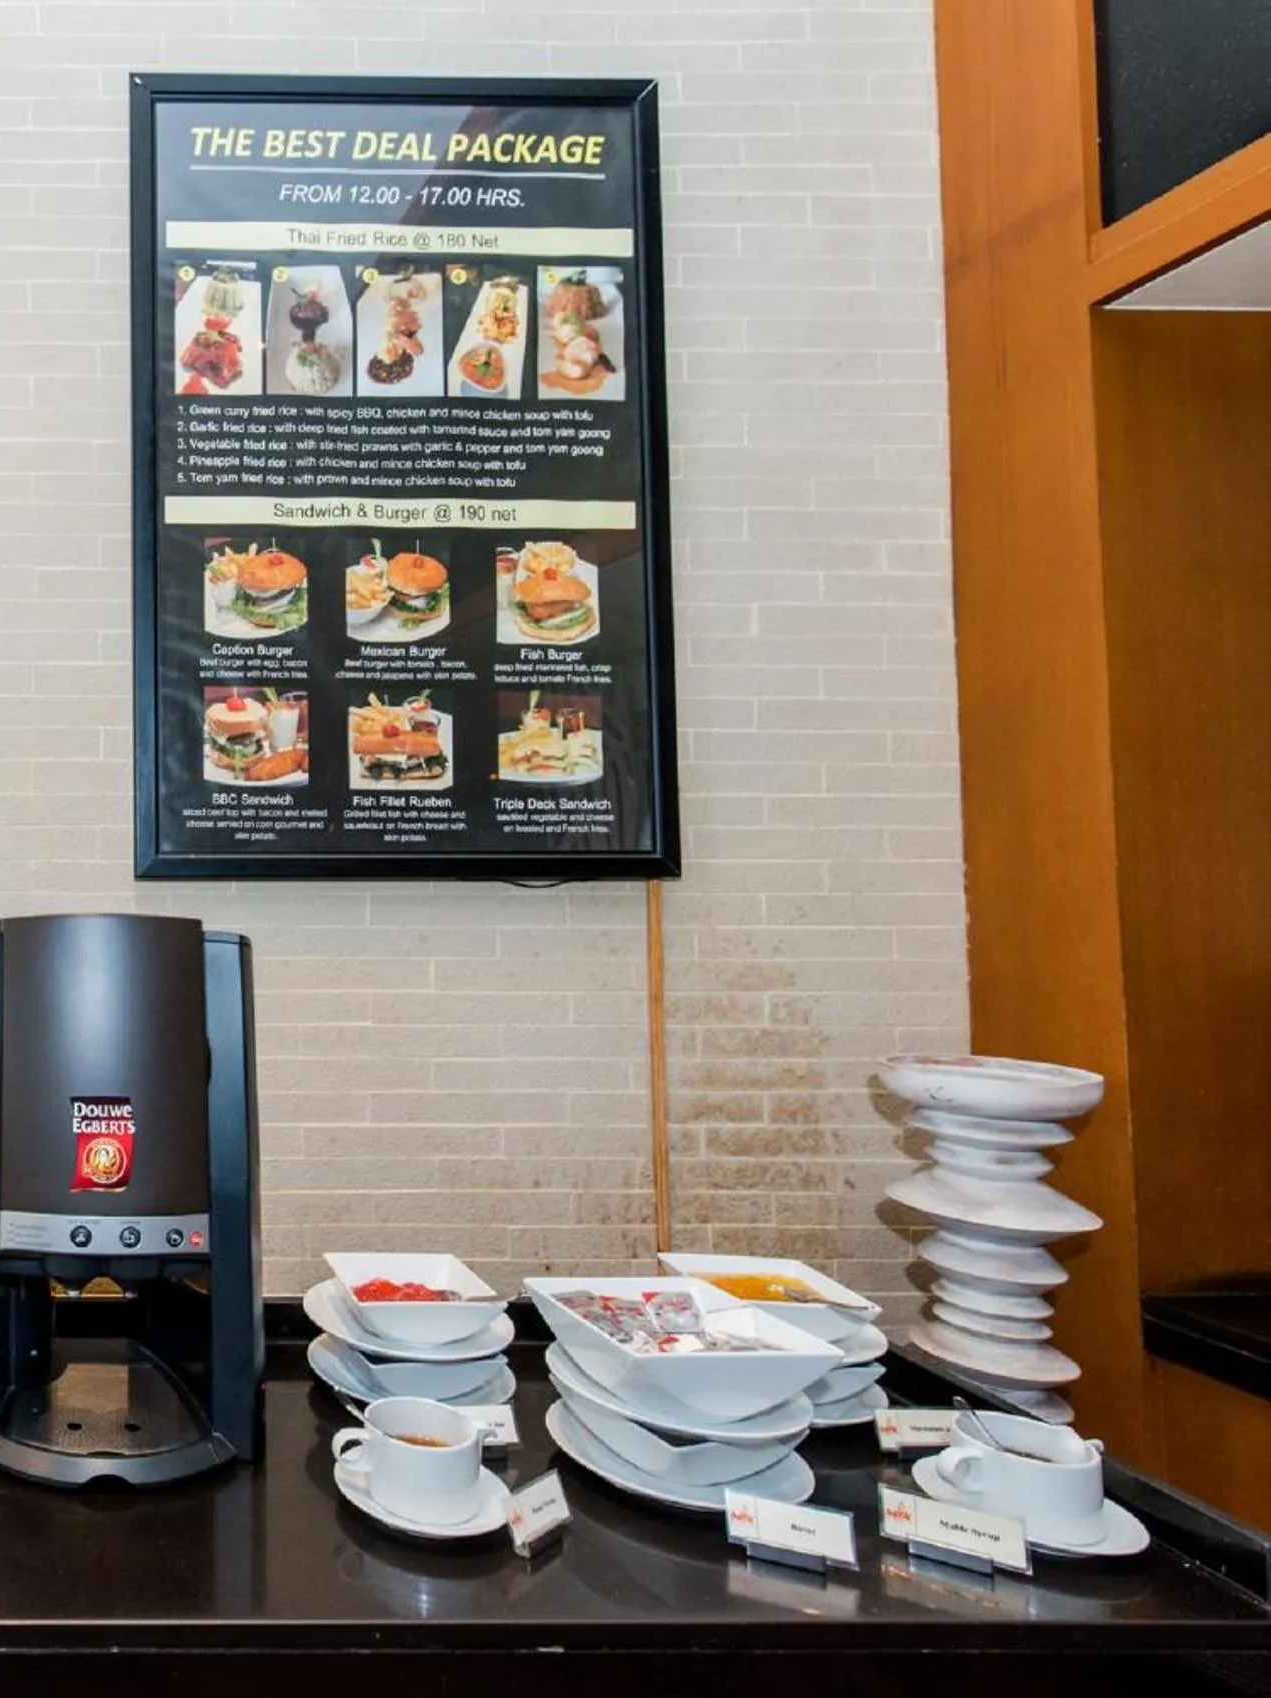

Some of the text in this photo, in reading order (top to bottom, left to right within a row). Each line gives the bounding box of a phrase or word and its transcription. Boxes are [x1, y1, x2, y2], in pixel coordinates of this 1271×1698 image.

[190, 127, 606, 165] THE BEST DEAL PACKAGE
[279, 184, 342, 203] FROM
[349, 185, 399, 204] 12.00
[419, 186, 472, 206] 17.00
[476, 188, 525, 207] HRS.
[288, 229, 499, 249] Thai Fried Rice @ 180 Net
[189, 404, 221, 416] Green
[223, 407, 249, 419] curry
[252, 406, 275, 416] fried
[278, 406, 297, 416] rice
[305, 406, 324, 416] with
[327, 407, 354, 421] spicy
[386, 407, 426, 418] chicken
[428, 407, 449, 418] and
[451, 408, 480, 419] mince
[482, 409, 521, 420] chicken
[524, 410, 550, 421] soup
[552, 409, 573, 420] with
[574, 409, 594, 421] tofu
[189, 421, 219, 432] Garlic
[223, 421, 245, 433] fried
[247, 422, 267, 433] rice
[274, 422, 296, 433] with
[298, 422, 324, 434] deep
[327, 423, 348, 435] fried
[350, 424, 369, 435] fish
[371, 424, 407, 435] coated
[409, 424, 430, 435] with
[433, 424, 476, 435] tamarind
[478, 426, 507, 437] sauce
[510, 426, 531, 437] and
[532, 426, 552, 437] tom
[555, 428, 575, 439] yam
[577, 429, 611, 440] goong
[189, 438, 241, 452] Vegetable
[243, 438, 265, 450] fried
[269, 440, 287, 450] rice
[296, 439, 317, 450] with
[362, 443, 399, 454] prawns
[400, 442, 422, 452] with
[424, 442, 453, 454] garlic
[455, 441, 463, 452] &
[465, 443, 501, 455] pepper
[503, 443, 523, 454] and
[525, 443, 546, 454] tom
[548, 444, 569, 456] yam
[571, 445, 604, 457] goong
[189, 455, 240, 468] Pineapple
[243, 455, 265, 467] fried
[267, 457, 287, 468] rice
[296, 456, 316, 467] with
[319, 457, 358, 468] chicken
[359, 458, 378, 469] and
[381, 458, 412, 469] mince
[415, 458, 455, 469] chicken
[457, 459, 482, 472] soup
[483, 460, 504, 470] with
[506, 460, 526, 471] tofu
[189, 472, 213, 483] Tom
[216, 473, 238, 486] yam
[241, 472, 264, 483] fried
[266, 474, 285, 485] rice
[293, 474, 315, 485] with
[316, 475, 348, 486] prawn
[350, 475, 370, 486] and
[371, 475, 403, 486] mince
[404, 475, 446, 486] chicken
[448, 477, 473, 488] soup
[474, 476, 495, 487] with
[496, 477, 516, 488] tofu
[273, 502, 517, 523] Sandwich & Burger @ 190 net
[257, 644, 294, 658] Burger
[360, 645, 447, 659] Mexican Burger
[520, 648, 583, 662] Fish Burger
[241, 793, 294, 806] Sandwich
[353, 796, 452, 807] Fish Fillet Rueben
[493, 797, 612, 810] Triple Deck Sandwich
[73, 1102, 134, 1118] Douwe
[72, 1117, 136, 1135] EGBERTS
